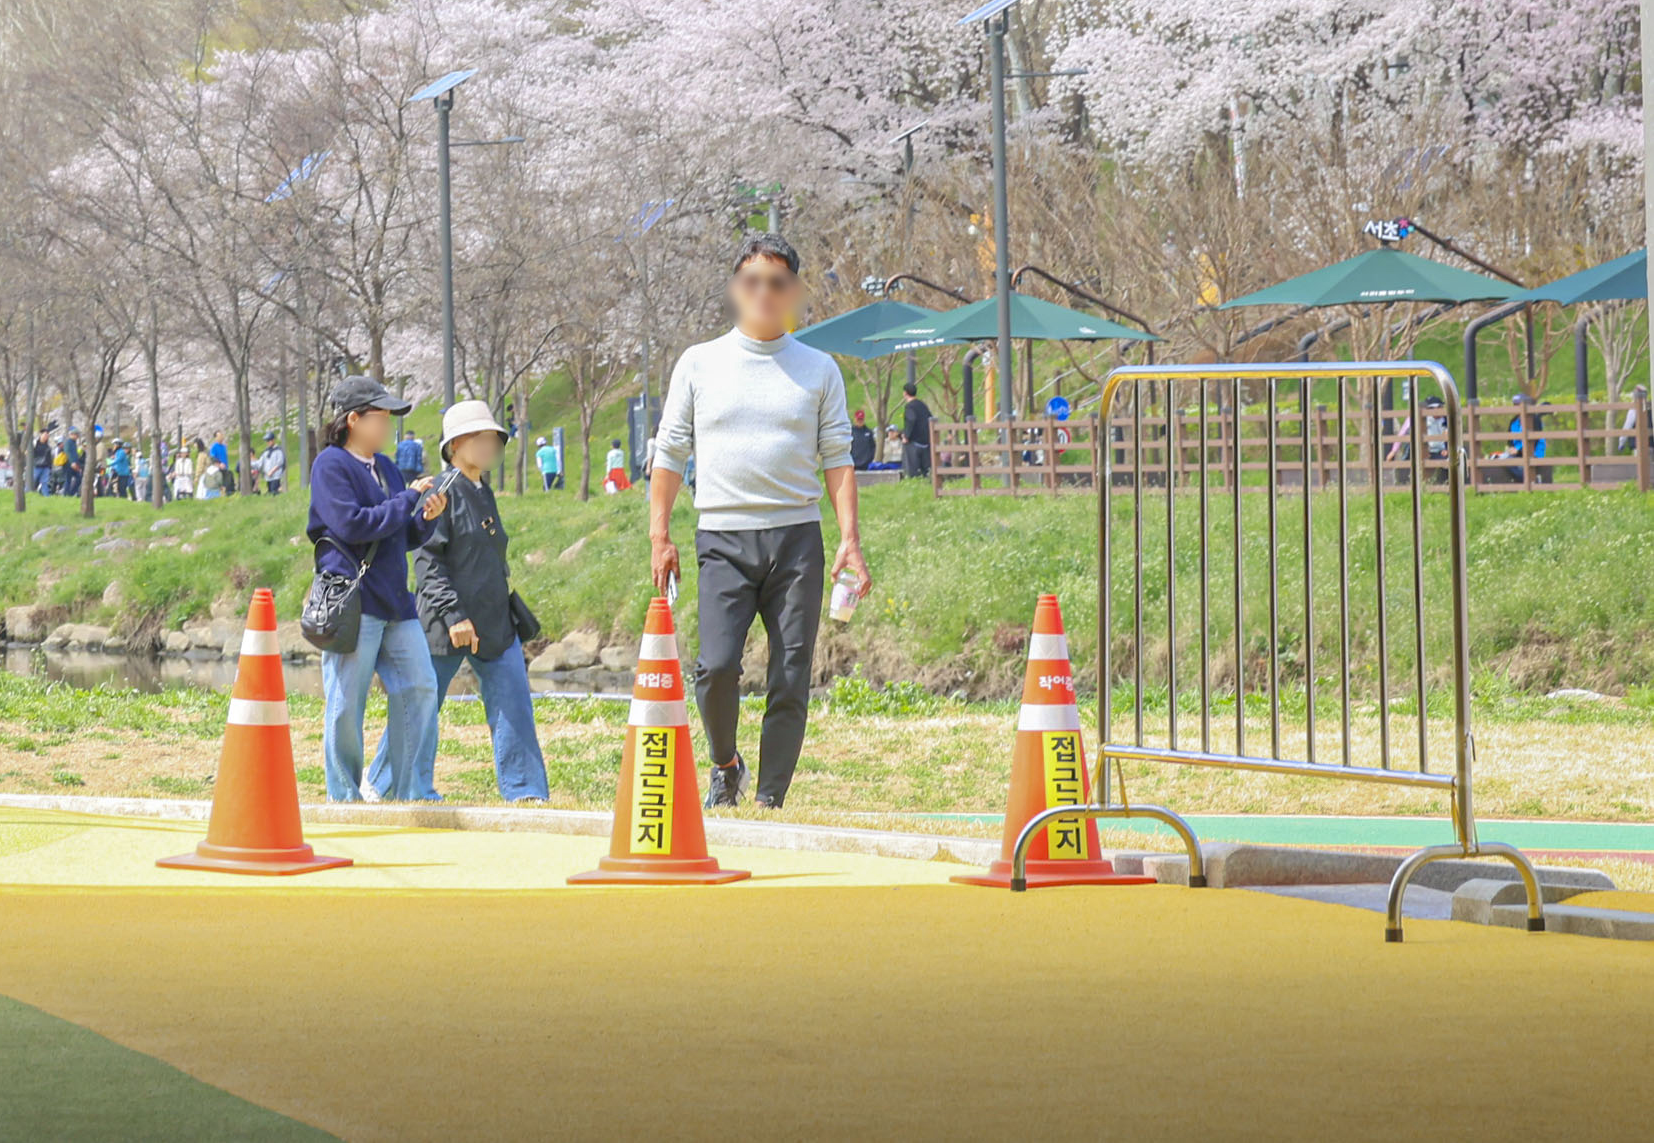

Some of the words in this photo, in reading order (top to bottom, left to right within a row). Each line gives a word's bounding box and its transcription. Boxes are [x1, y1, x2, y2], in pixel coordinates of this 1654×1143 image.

[1364, 220, 1400, 241] 서초
[637, 672, 674, 689] 작업중
[637, 732, 668, 849] 접근금지
